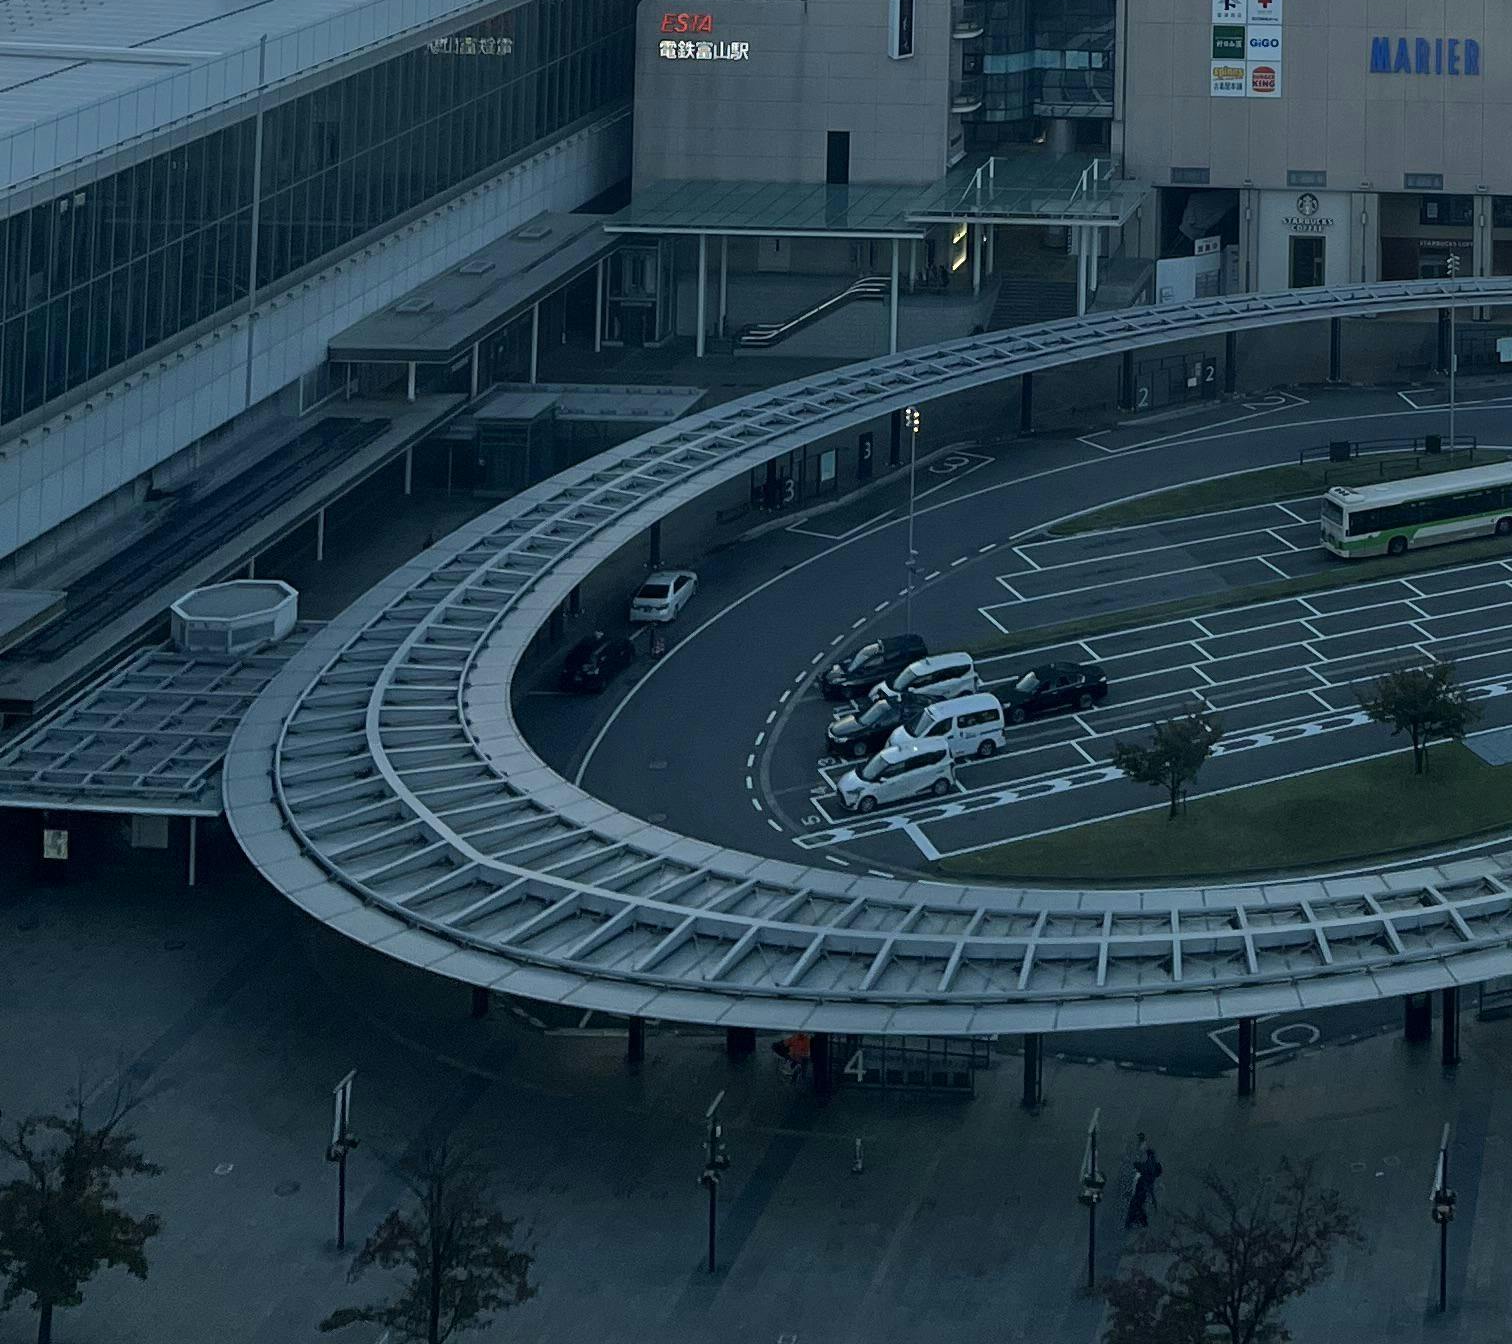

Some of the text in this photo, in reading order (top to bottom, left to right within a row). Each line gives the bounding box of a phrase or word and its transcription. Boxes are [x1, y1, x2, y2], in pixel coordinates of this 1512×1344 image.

[661, 13, 713, 33] ESTA
[659, 40, 750, 60] 電鉄富山駅
[1250, 38, 1279, 48] GiGO
[1370, 36, 1480, 76] MARIER
[1253, 79, 1275, 88] KING
[1282, 216, 1334, 226] STARBUCKS
[1291, 225, 1324, 233] COFFEE
[1206, 365, 1215, 382] 2
[1137, 387, 1149, 407] 2
[864, 441, 871, 459] 3
[783, 478, 795, 502] 3
[843, 1048, 867, 1083] 4
